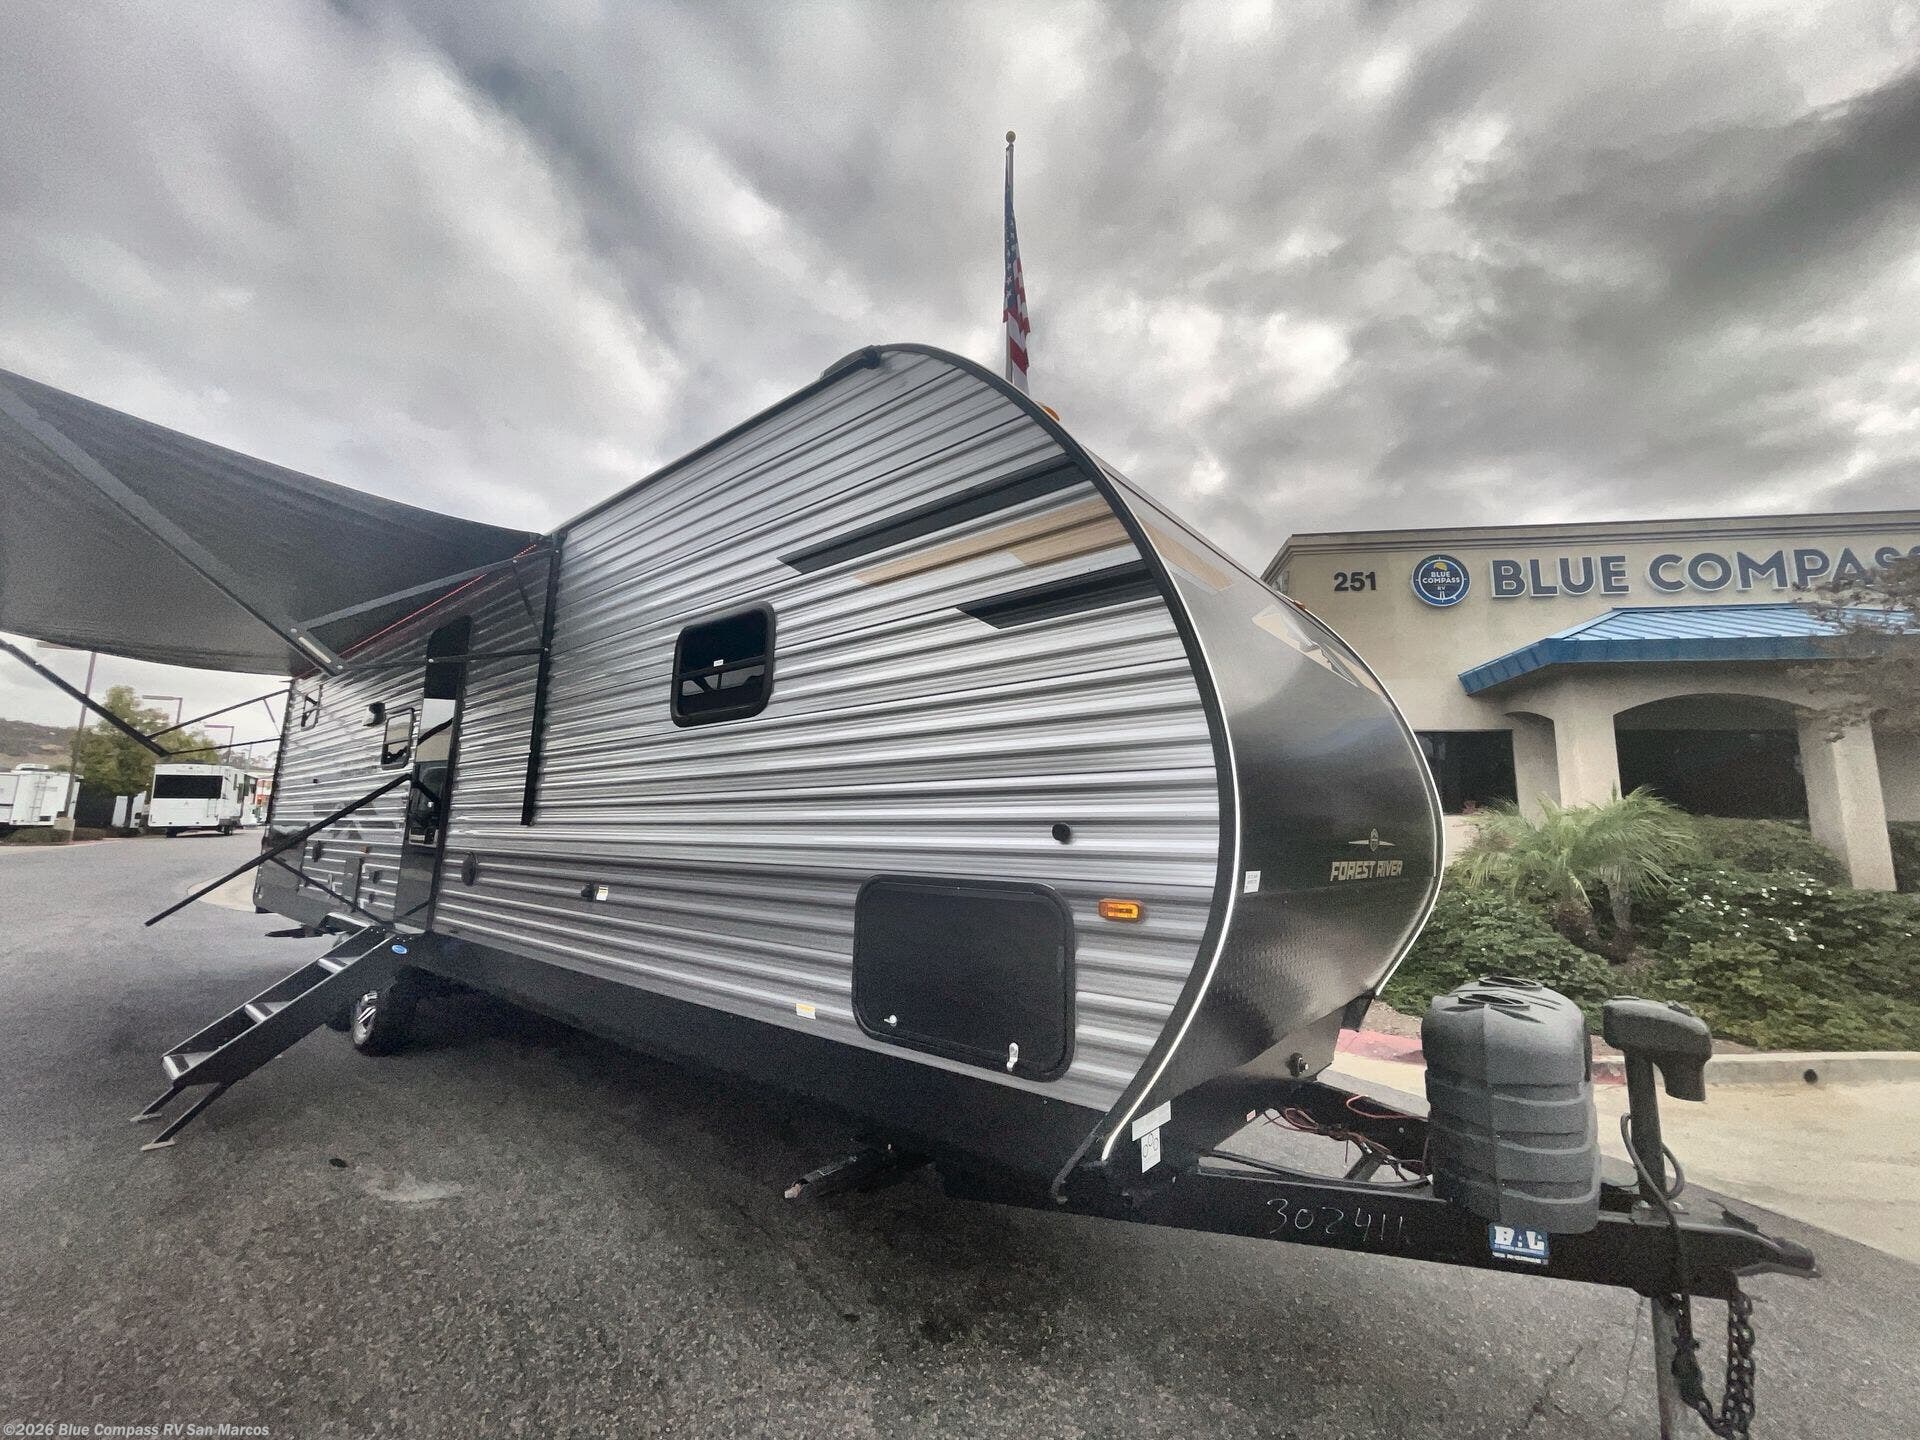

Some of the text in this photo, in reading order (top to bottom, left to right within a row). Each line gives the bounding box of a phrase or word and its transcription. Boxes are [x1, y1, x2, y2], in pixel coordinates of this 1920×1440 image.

[1334, 571, 1376, 592] 251
[1490, 545, 1920, 599] BLUE COMPAS
[1330, 860, 1403, 881] FOREST RIVER
